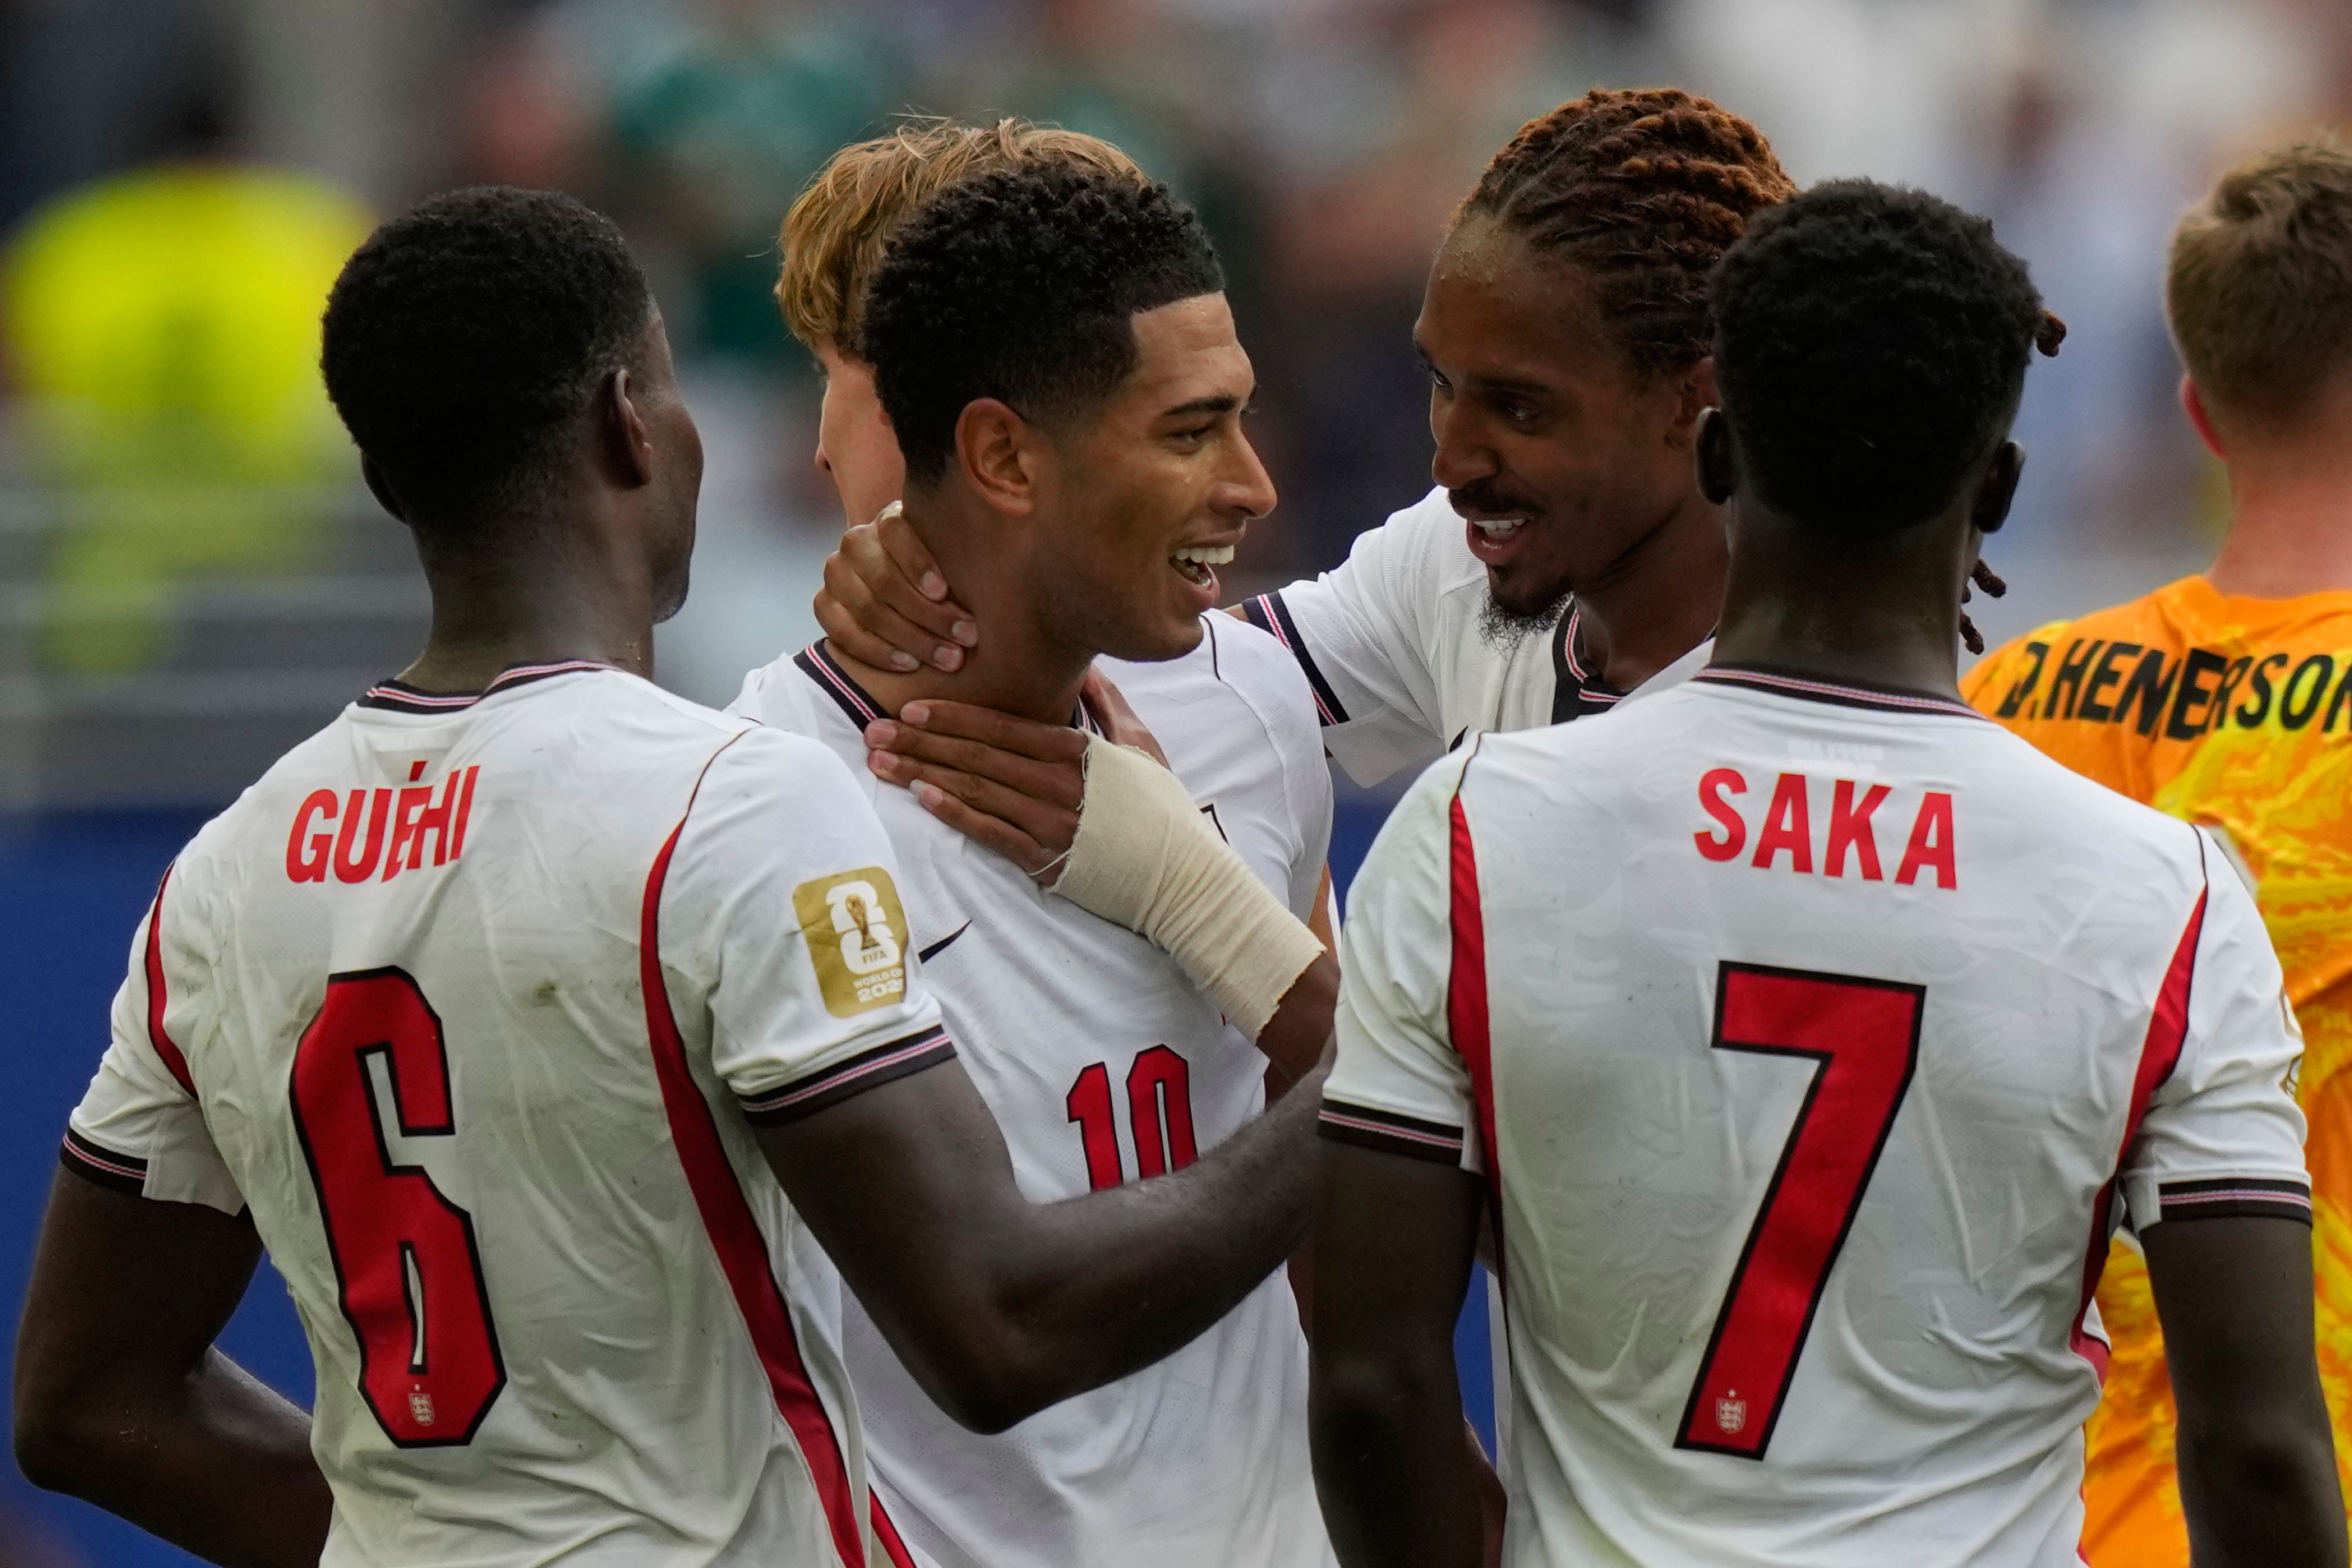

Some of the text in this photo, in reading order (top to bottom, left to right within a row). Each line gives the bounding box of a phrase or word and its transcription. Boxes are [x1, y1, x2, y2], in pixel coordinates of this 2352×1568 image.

[286, 761, 481, 884] GUÉHI
[1694, 768, 1957, 890] SAKA
[853, 971, 890, 989] WORLD
[862, 950, 888, 964] FIFA
[1066, 1043, 1199, 1194] 10
[289, 965, 508, 1449] 6
[1673, 961, 1927, 1460] 7
